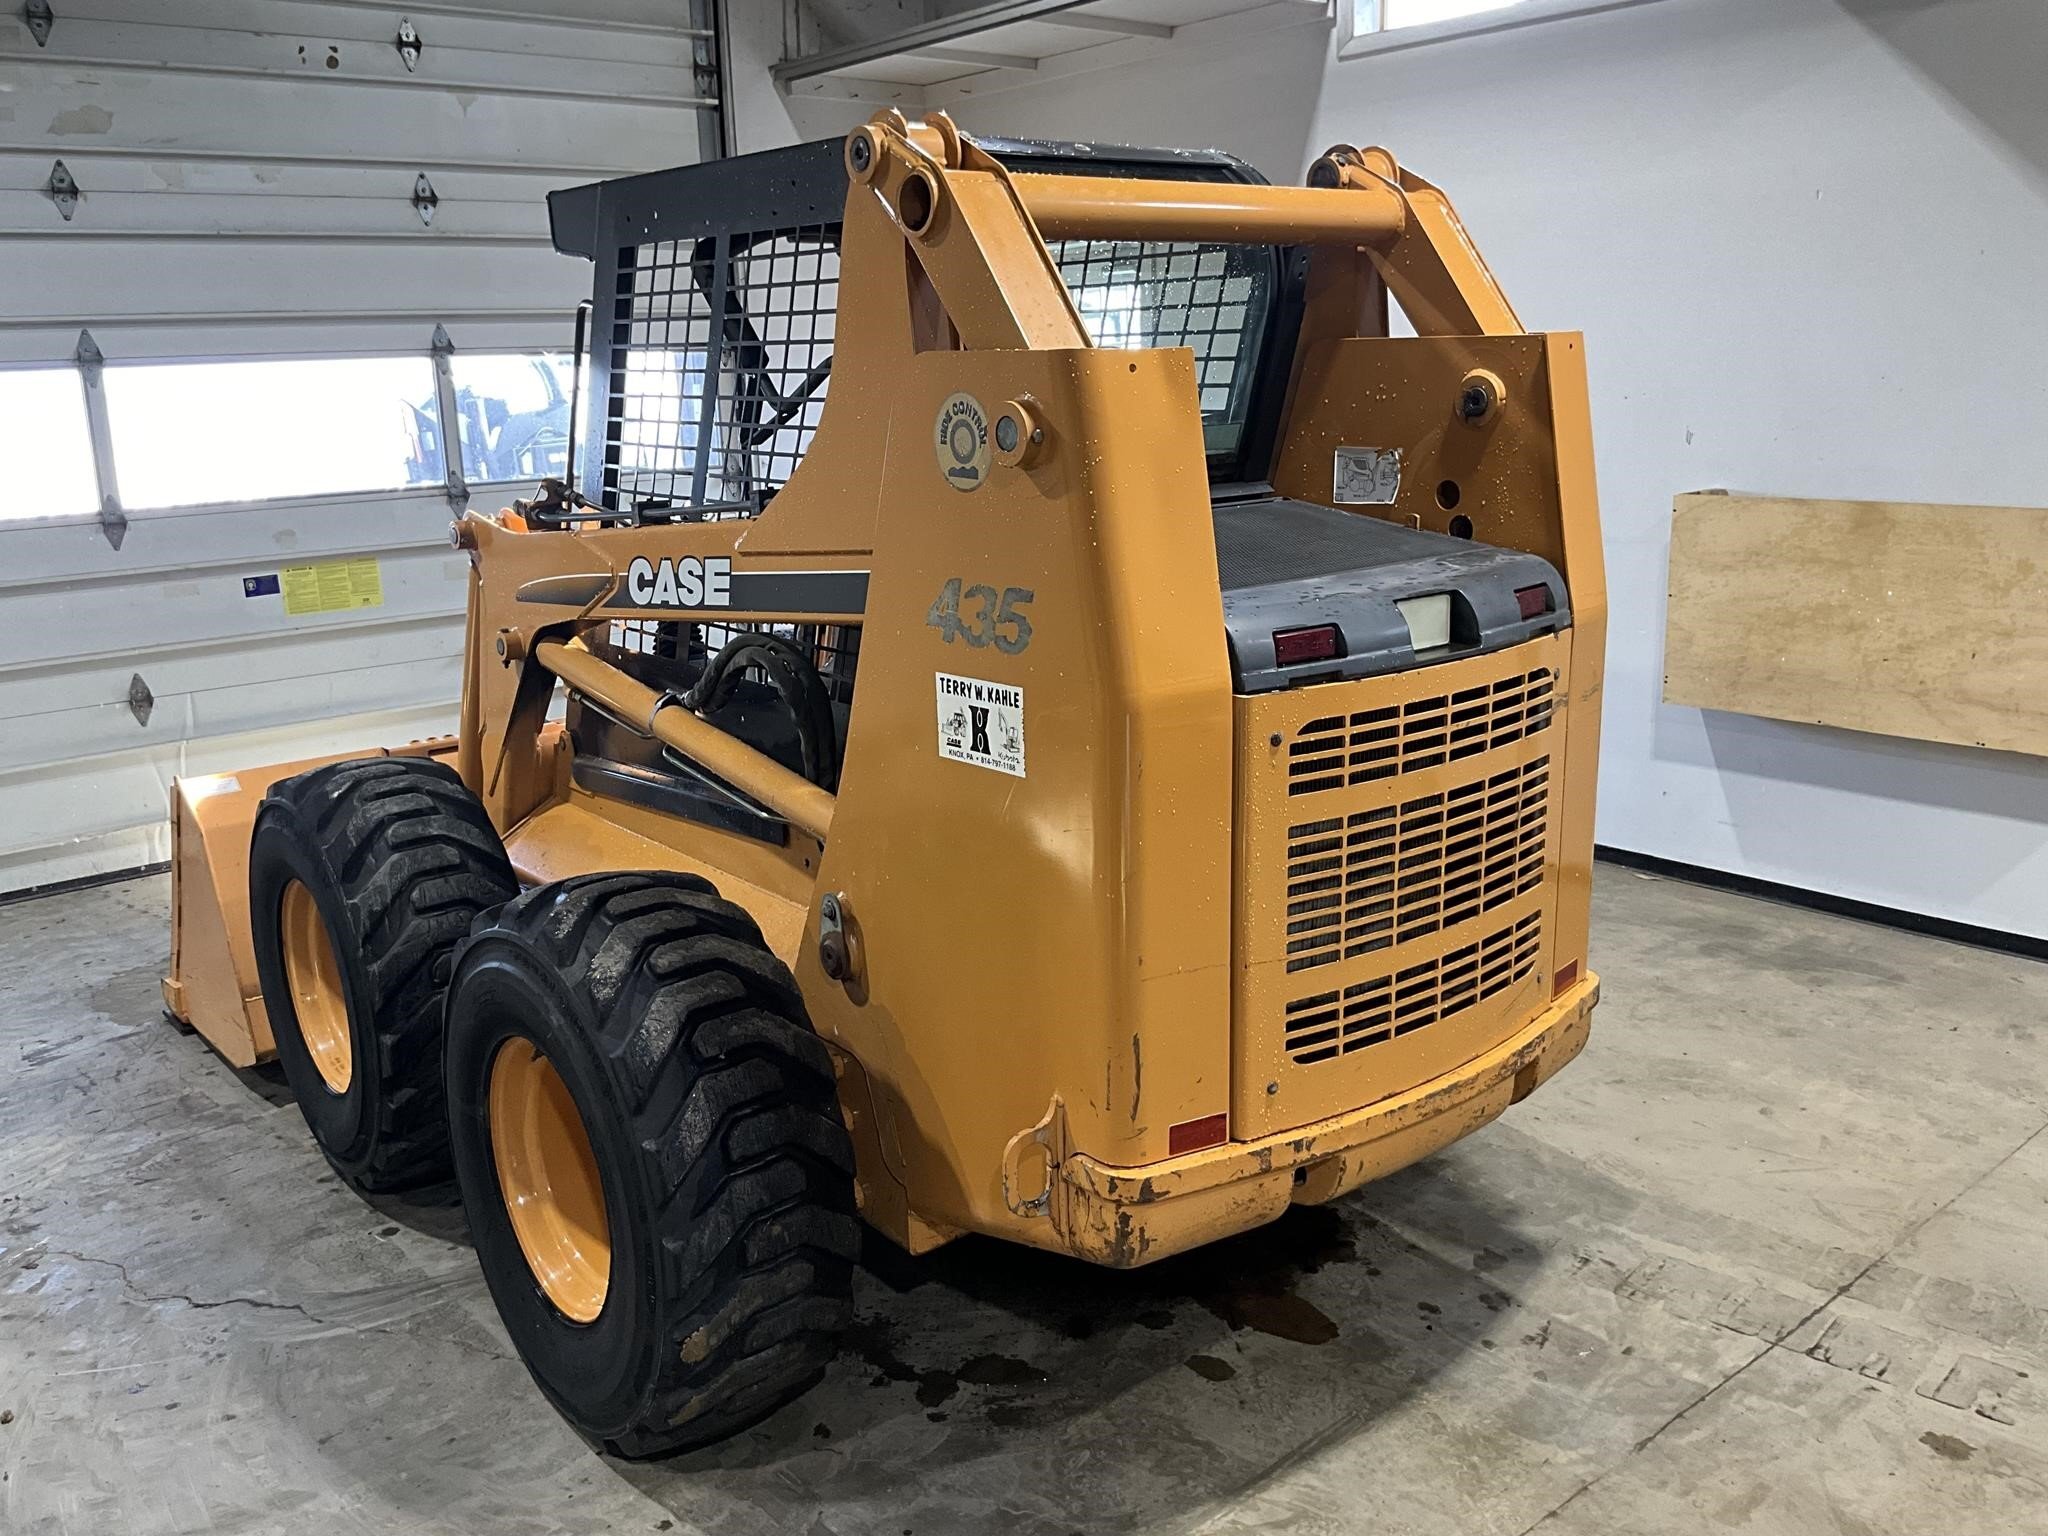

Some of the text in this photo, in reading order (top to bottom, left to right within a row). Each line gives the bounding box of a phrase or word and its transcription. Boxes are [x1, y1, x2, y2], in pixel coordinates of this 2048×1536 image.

[627, 555, 732, 607] CASE
[925, 577, 1035, 656] 435
[940, 677, 1020, 708] TERRY W. KAHLE
[948, 748, 966, 761] KNOX,
[966, 752, 974, 761] PA
